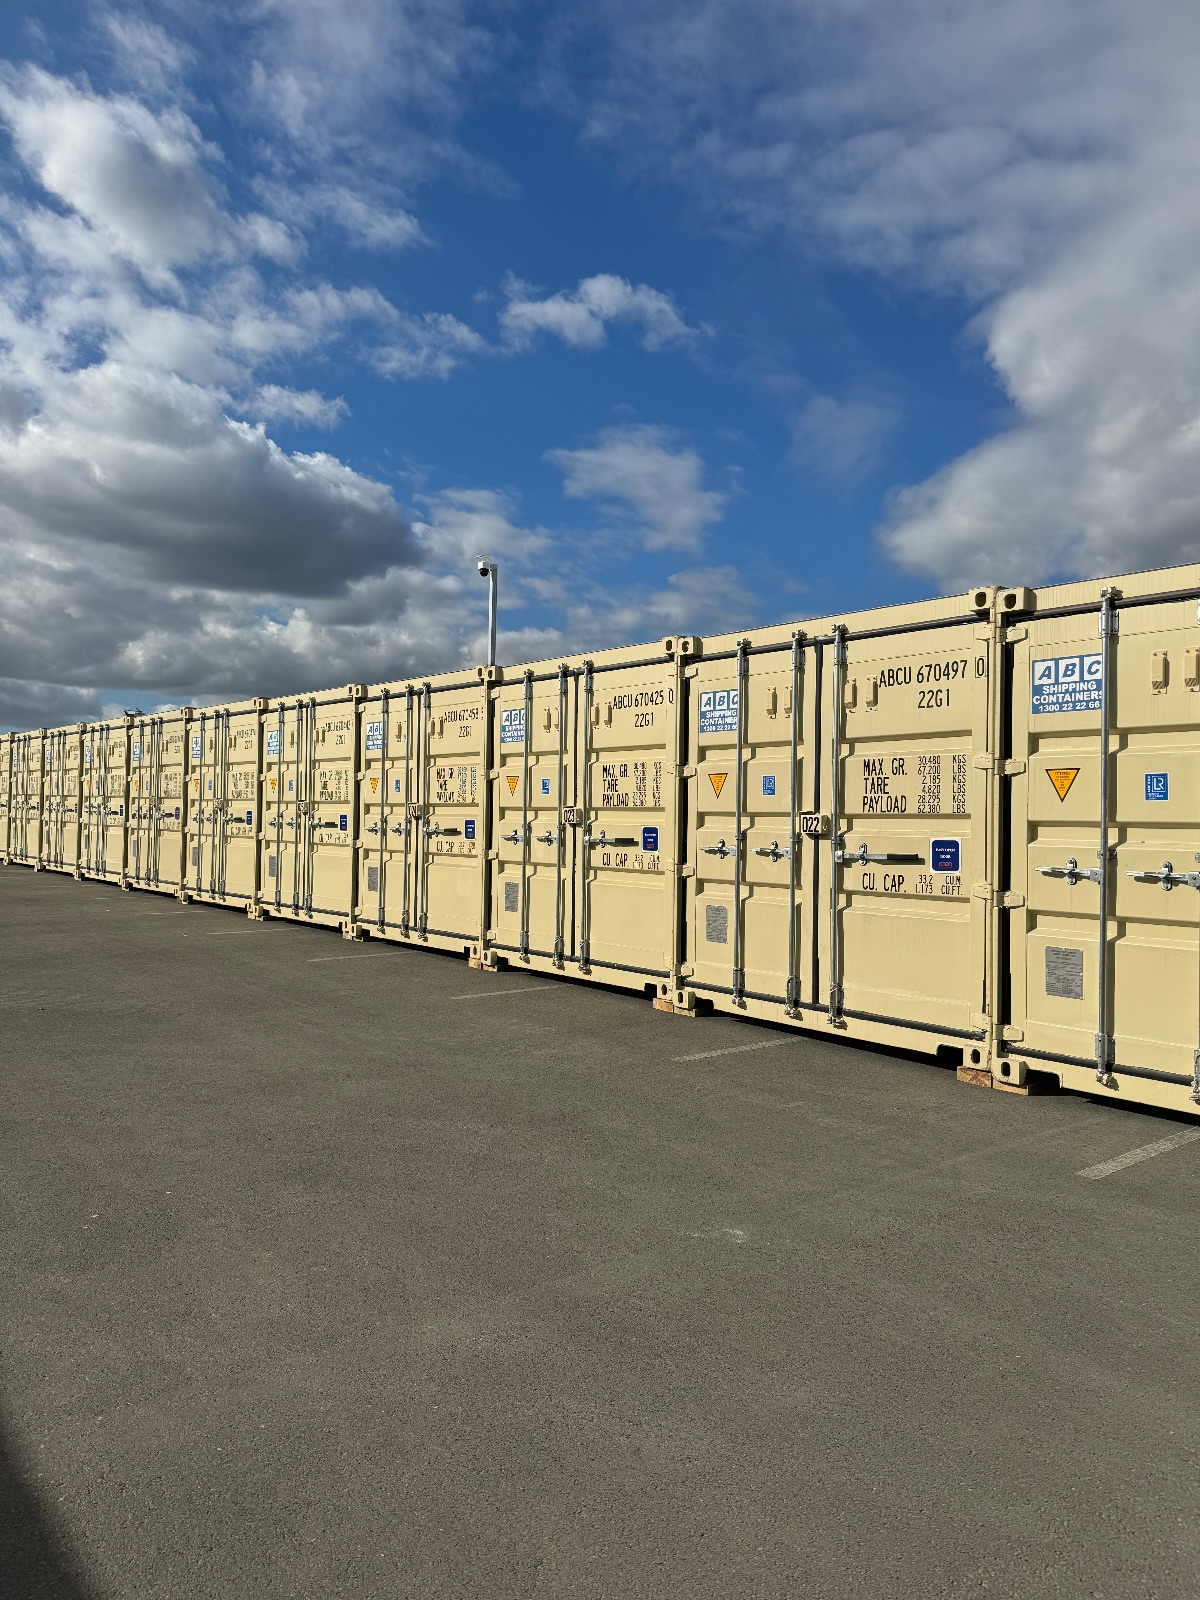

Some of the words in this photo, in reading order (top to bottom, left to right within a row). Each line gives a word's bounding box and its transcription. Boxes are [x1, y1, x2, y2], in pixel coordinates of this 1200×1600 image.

[879, 666, 912, 688] ABCU
[916, 659, 968, 684] 670497
[1042, 681, 1097, 694] SHIPPING
[612, 693, 633, 710] ABCU
[634, 689, 664, 708] 670425
[917, 688, 950, 709] 22G1
[705, 709, 737, 718] SHIPPING
[1038, 704, 1060, 712] 1300
[1061, 703, 1073, 711] 22
[1075, 702, 1087, 710] 22
[1088, 701, 1100, 709] 66
[634, 712, 654, 728] 22G1
[952, 753, 967, 764] KGS
[863, 758, 887, 777] MAX.
[891, 757, 908, 776] GR.
[952, 764, 967, 774] LBS
[602, 779, 619, 793] TARE
[863, 776, 890, 795] TARE
[952, 774, 967, 784] KGS
[952, 784, 966, 794] LBS
[602, 792, 630, 807] PAYLOAD
[862, 795, 907, 813] PAYLOAD
[952, 794, 966, 803] KGS
[563, 809, 575, 823] 023
[952, 804, 966, 814] LBS
[802, 816, 820, 833] 022
[862, 872, 878, 891] CU.
[883, 873, 907, 893] CAP.
